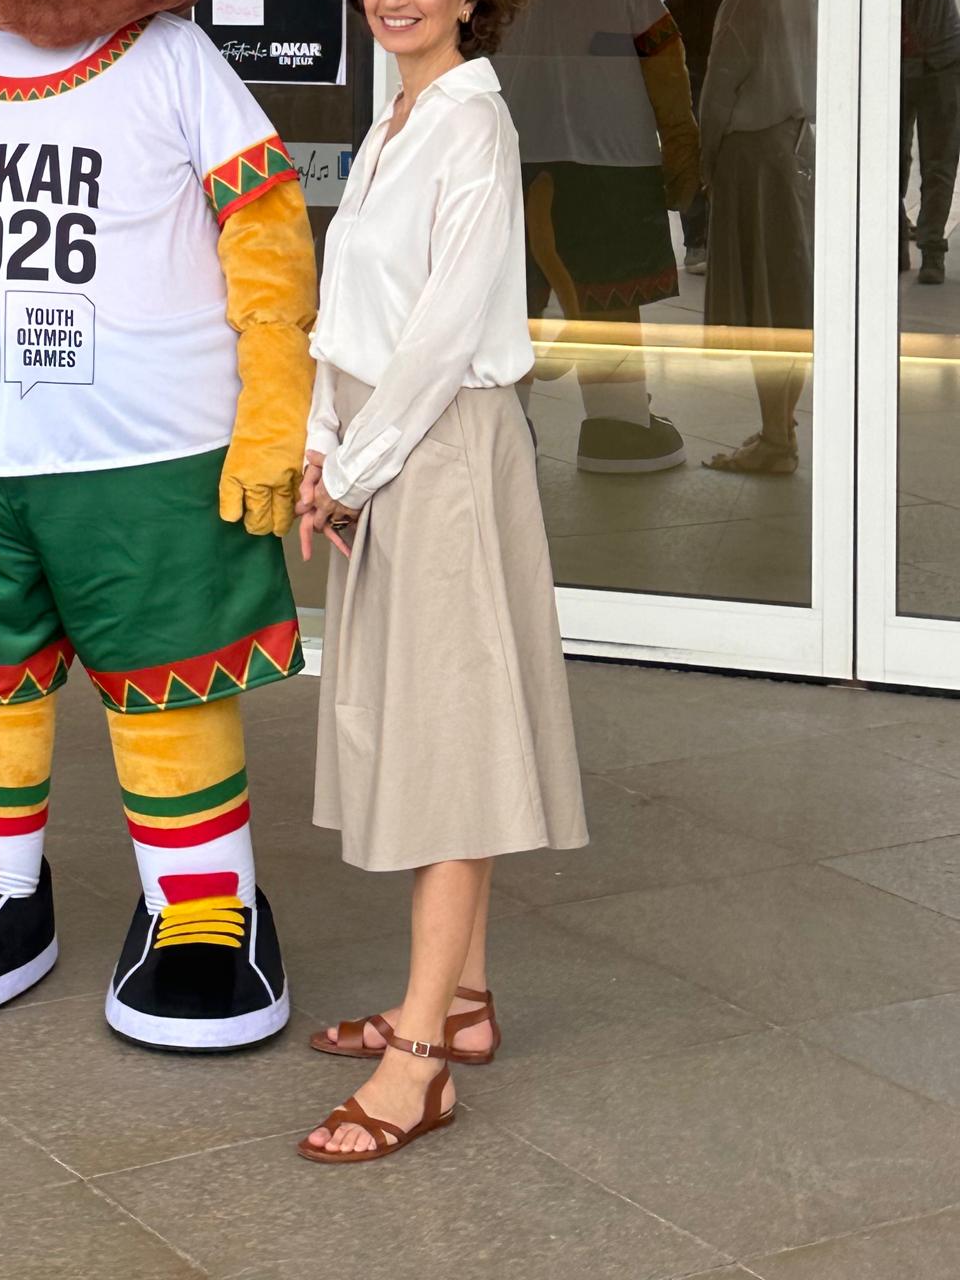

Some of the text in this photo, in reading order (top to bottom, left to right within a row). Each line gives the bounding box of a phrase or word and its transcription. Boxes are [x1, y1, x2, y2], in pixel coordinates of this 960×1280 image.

[270, 42, 321, 57] DAKAR
[279, 56, 314, 68] EN JEUX
[25, 307, 74, 327] YOUTH
[16, 329, 83, 348] OLYMPIC
[23, 349, 76, 368] GAMES
